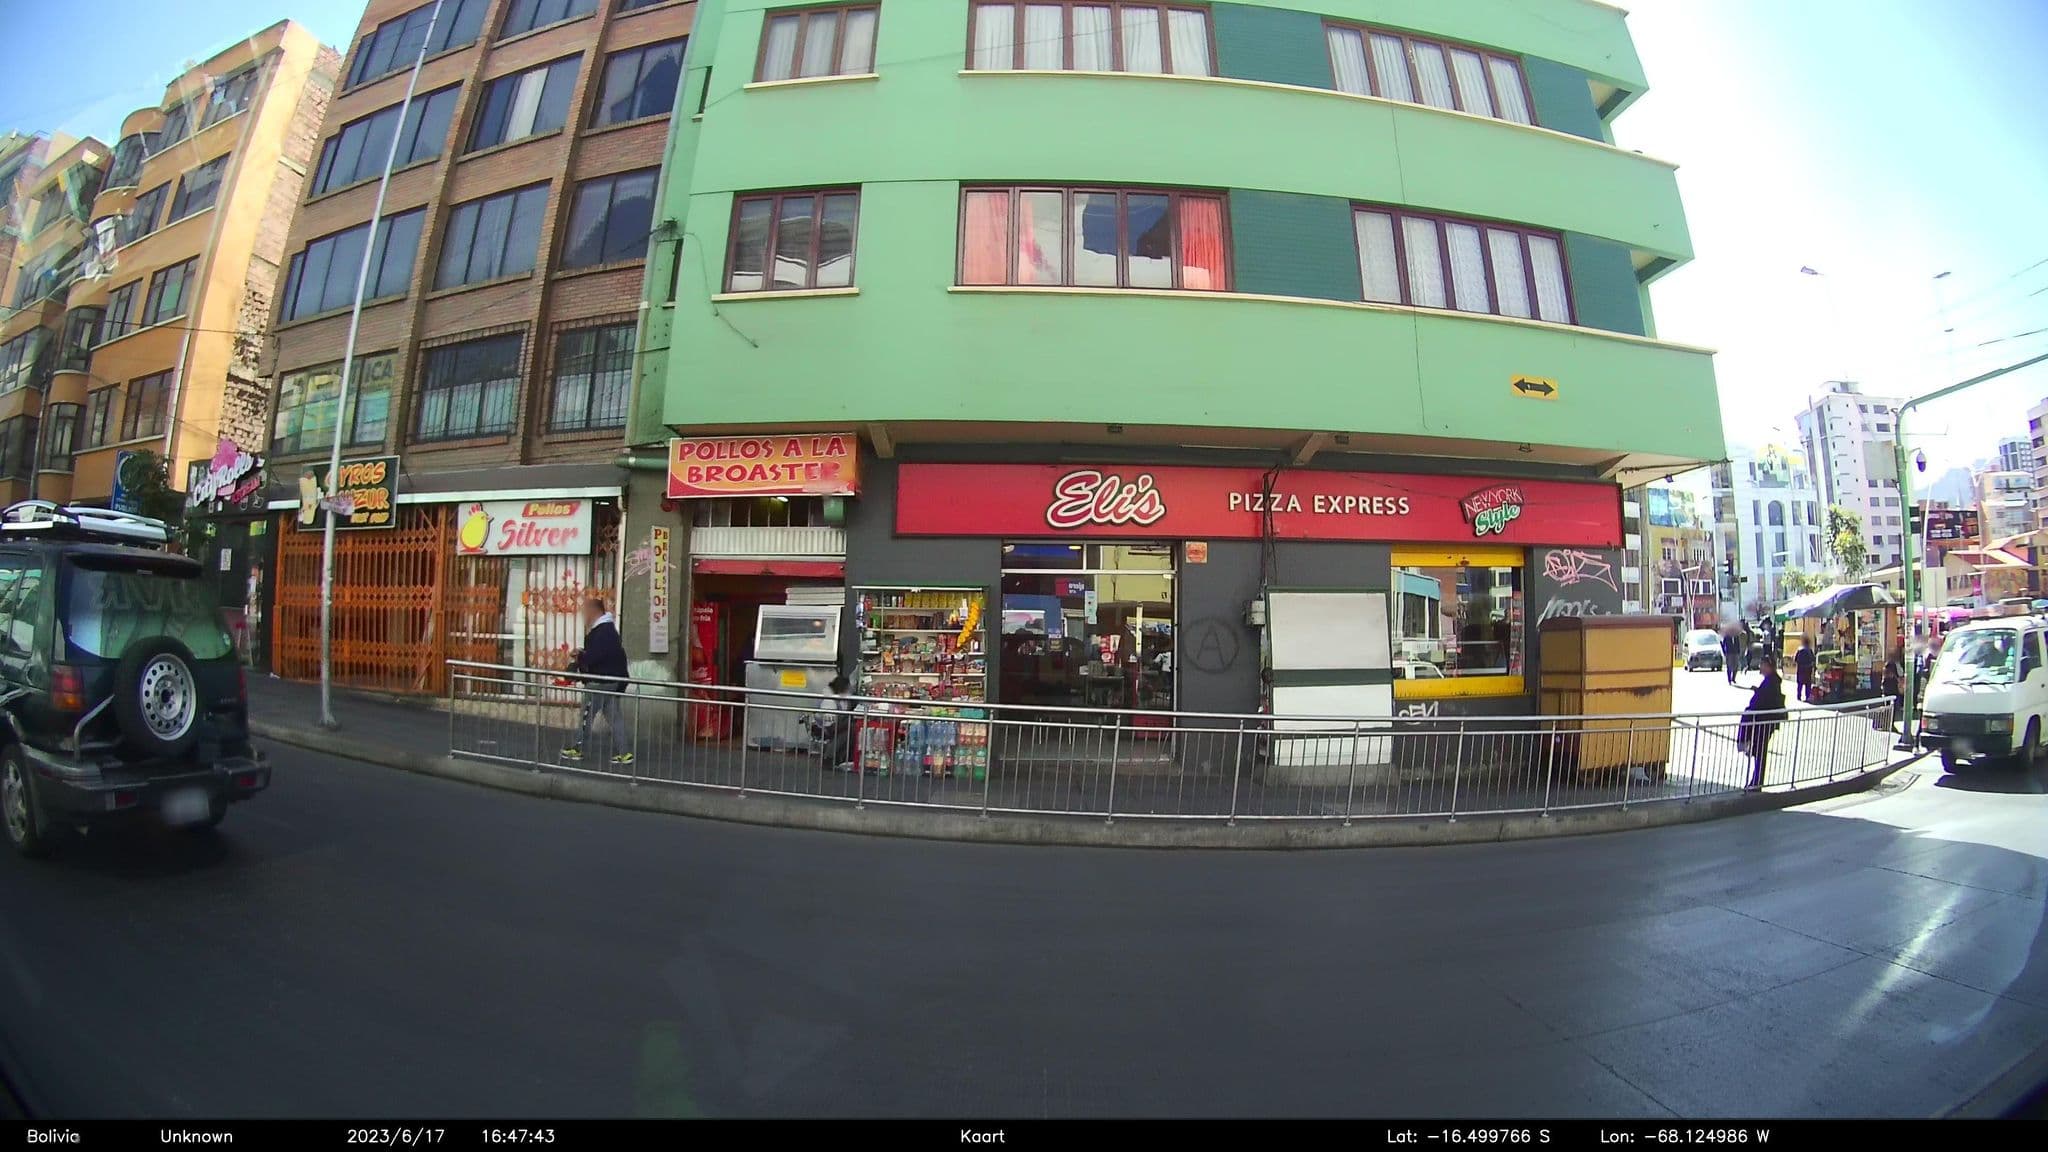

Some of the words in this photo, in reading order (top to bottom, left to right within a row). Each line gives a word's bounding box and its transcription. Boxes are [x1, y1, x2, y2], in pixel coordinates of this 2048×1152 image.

[678, 439, 774, 462] POLLOS
[783, 438, 803, 458] A
[812, 437, 848, 457] LA
[528, 502, 572, 516] Pollos
[1046, 470, 1166, 528] Eli's
[1228, 492, 1302, 512] PIZZA
[1313, 495, 1411, 515] EXPRESS
[1474, 500, 1521, 537] Style
[498, 519, 580, 551] Silver
[653, 528, 663, 623] POLLOS
